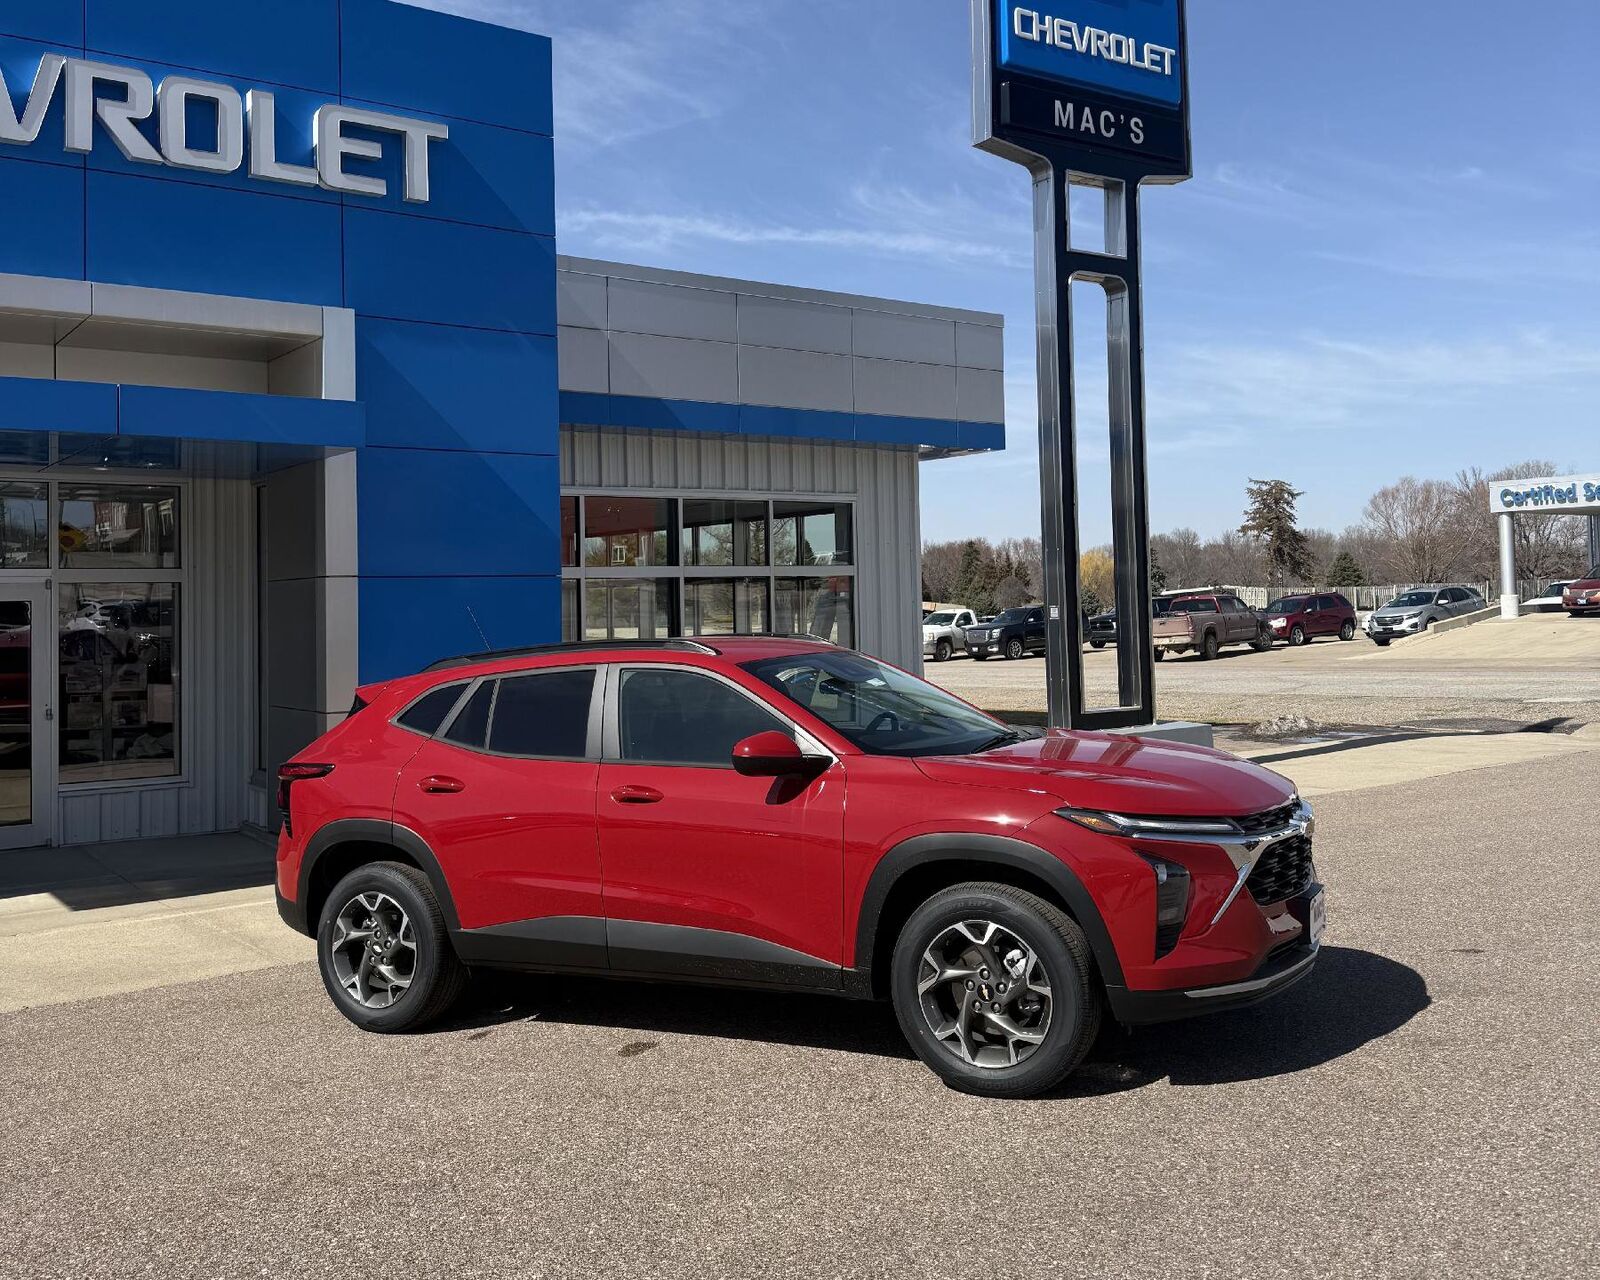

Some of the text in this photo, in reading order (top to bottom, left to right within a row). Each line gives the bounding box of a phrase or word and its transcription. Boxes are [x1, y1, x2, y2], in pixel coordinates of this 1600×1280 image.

[1014, 7, 1176, 75] CHEVROLET
[1054, 100, 1145, 144] MAC'S
[1500, 483, 1578, 506] Certified
